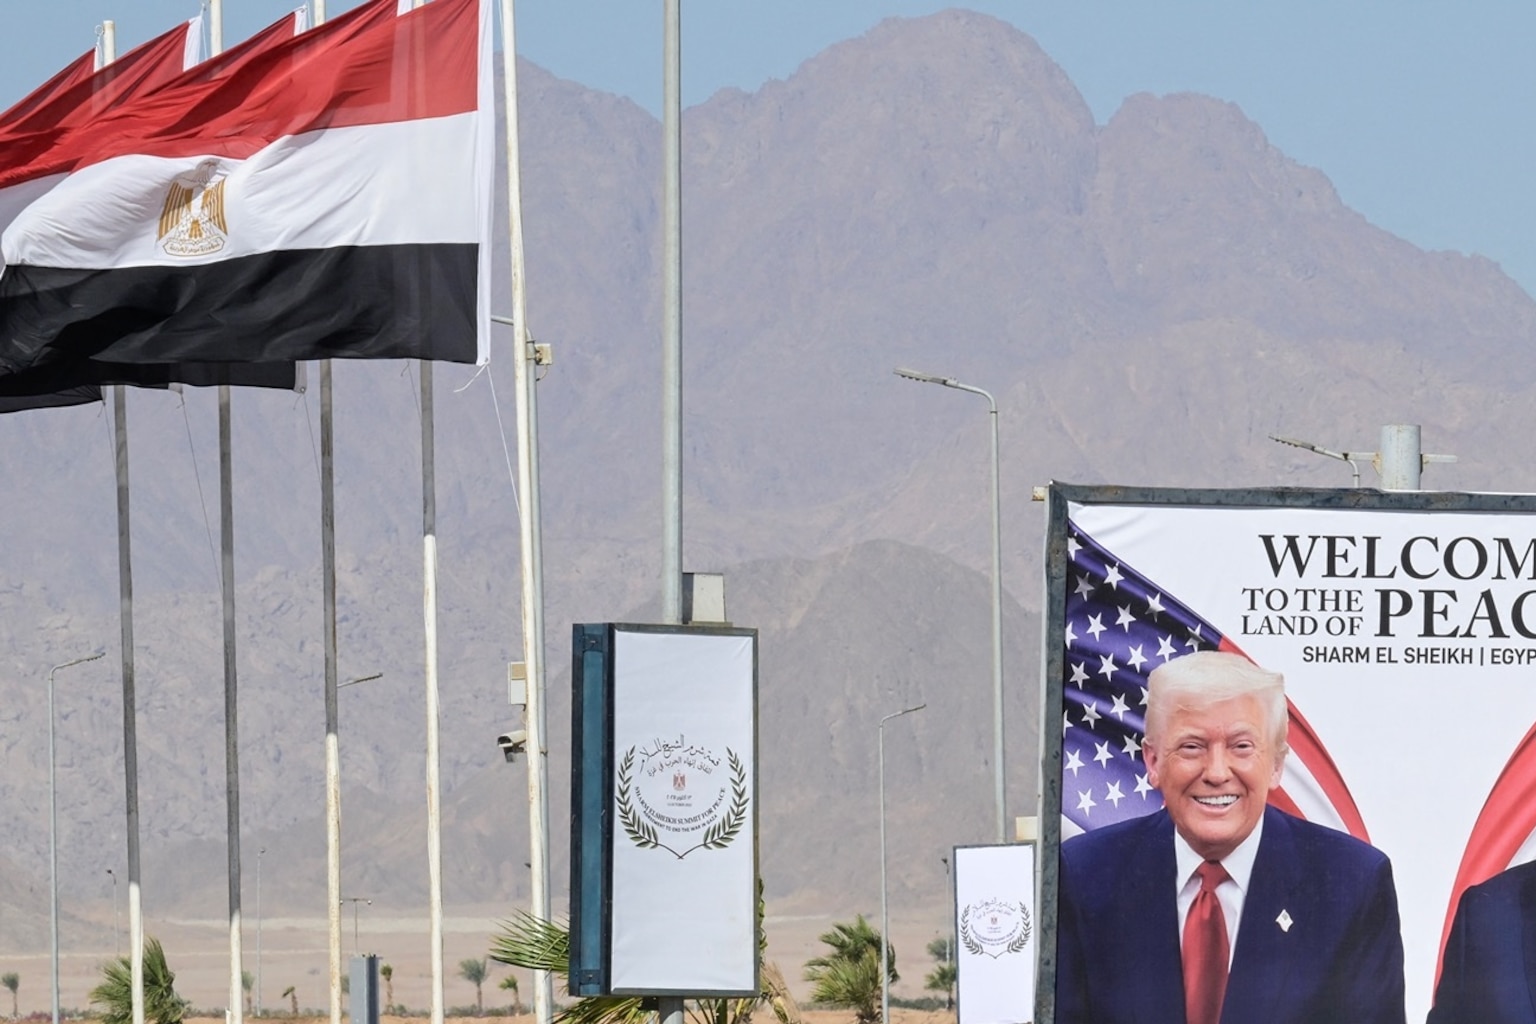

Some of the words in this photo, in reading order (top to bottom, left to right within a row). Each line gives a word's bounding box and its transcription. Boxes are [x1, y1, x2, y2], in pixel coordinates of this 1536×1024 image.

[1242, 588, 1288, 611] TO
[1294, 588, 1364, 612] THE
[1241, 615, 1318, 636] LAND
[1325, 616, 1364, 636] OF
[1303, 646, 1370, 663] SHARM
[1376, 647, 1398, 663] EL
[1404, 647, 1473, 664] SHEIKH
[635, 786, 650, 812] SHARM
[677, 815, 701, 825] SUMMIT
[701, 808, 713, 819] FOR
[712, 787, 726, 810] PEACE
